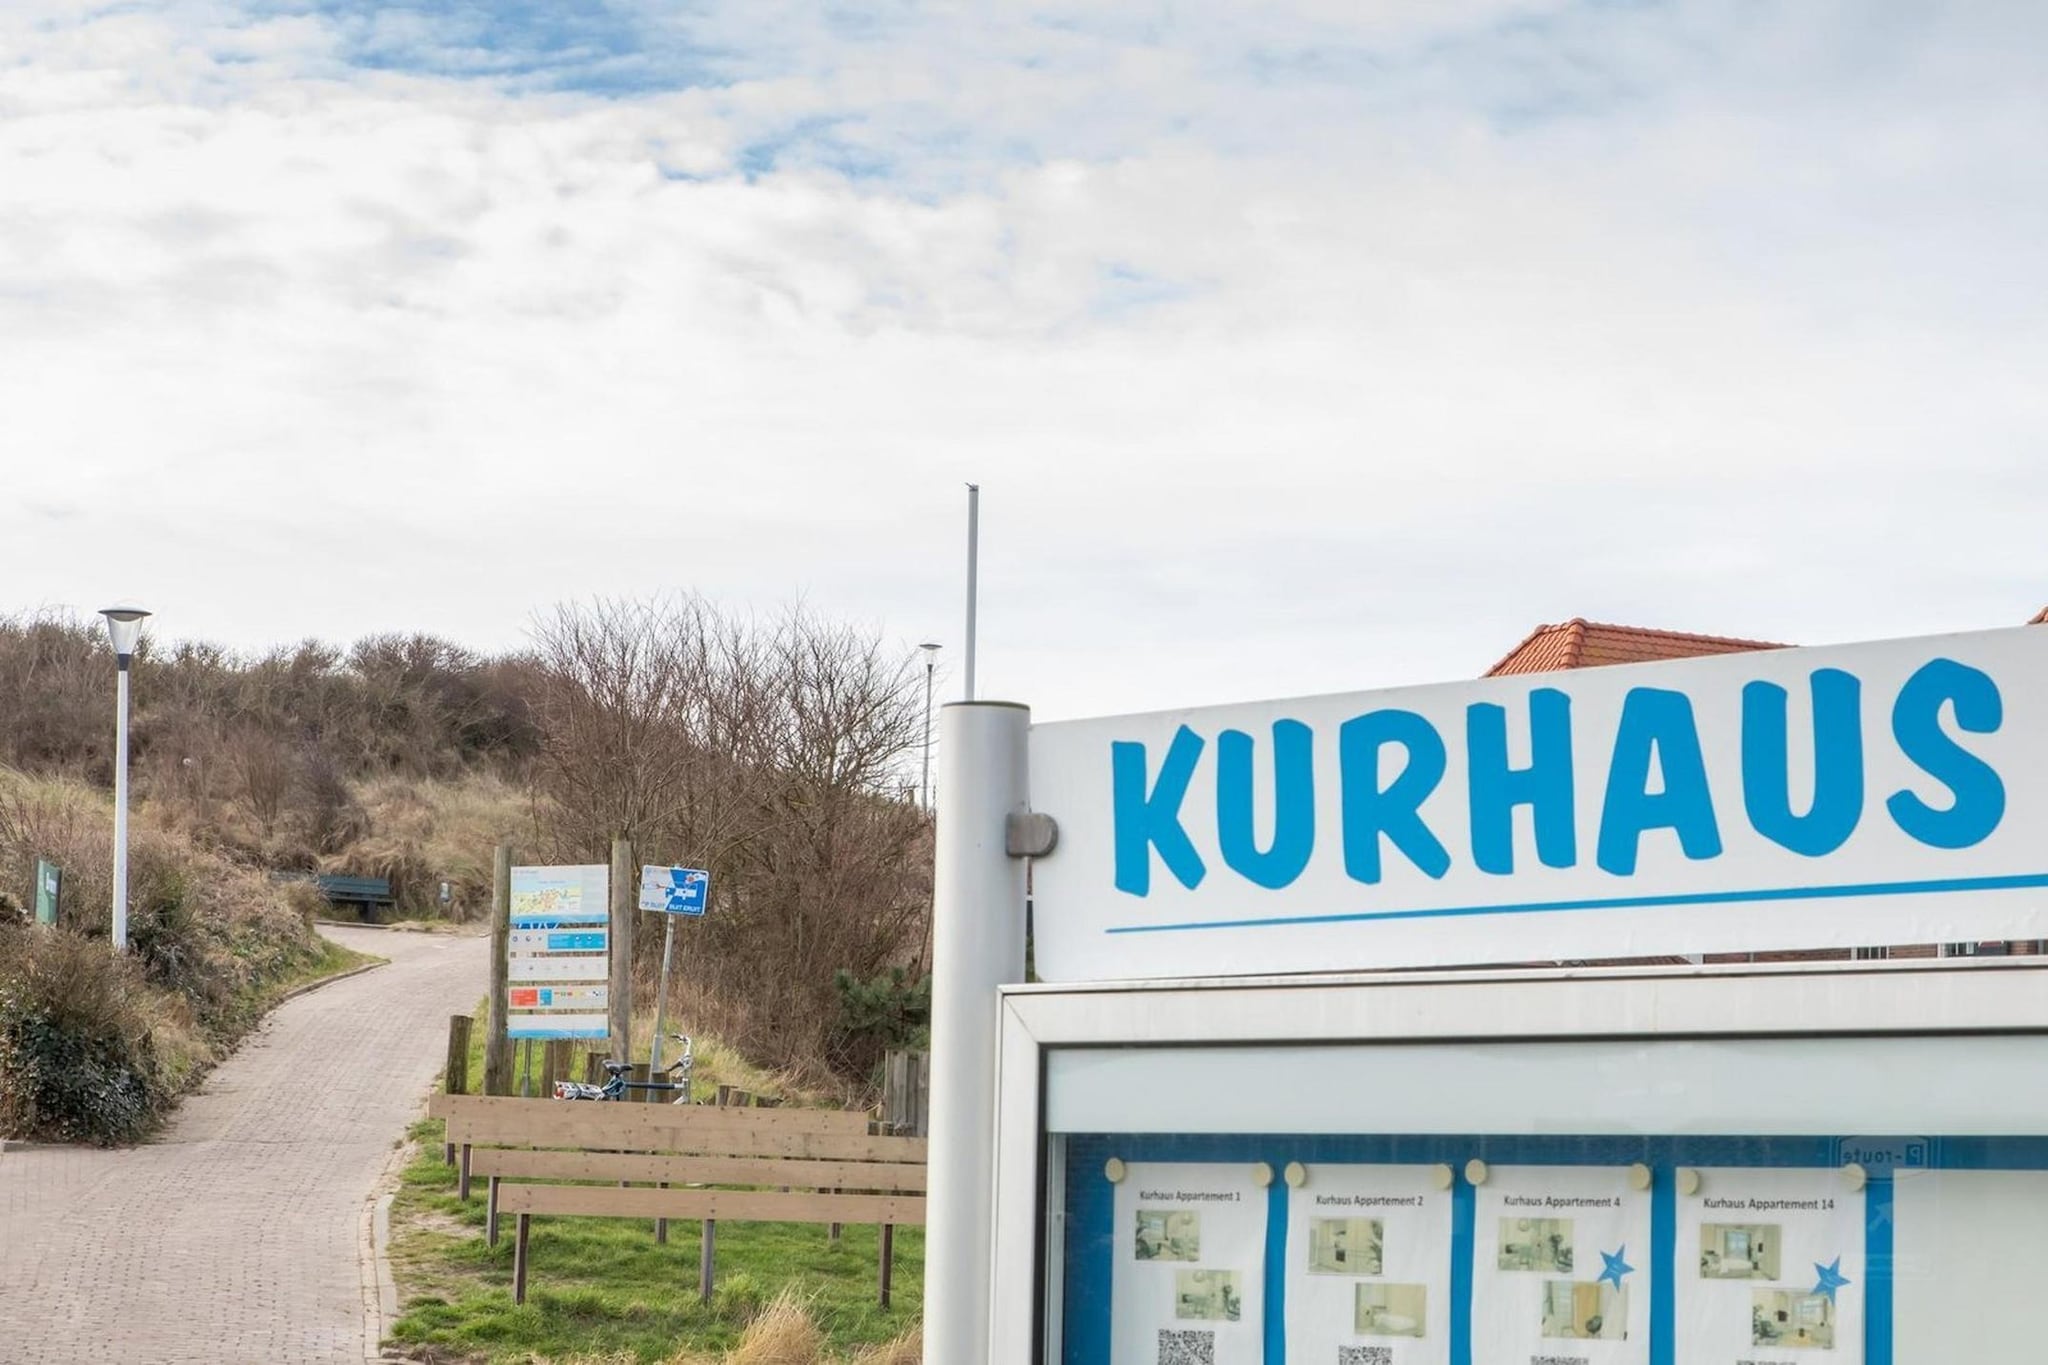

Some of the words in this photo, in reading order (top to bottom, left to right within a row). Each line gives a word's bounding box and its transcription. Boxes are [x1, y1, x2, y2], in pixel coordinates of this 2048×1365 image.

[1111, 656, 2006, 898] KURHAUS
[1140, 1190, 1174, 1201] Kurhaus
[1175, 1190, 1234, 1203] Appartement
[1235, 1192, 1241, 1202] 1
[1316, 1195, 1352, 1206] Kurhaus
[1354, 1195, 1416, 1208] Appartement
[1417, 1196, 1424, 1207] 2
[1504, 1196, 1542, 1207] Kurhaus
[1544, 1196, 1611, 1209] Appartement
[1613, 1197, 1621, 1208] 4
[1703, 1197, 1745, 1209] Kurhaus
[1747, 1198, 1818, 1211] Appartement
[1821, 1199, 1835, 1211] 14
